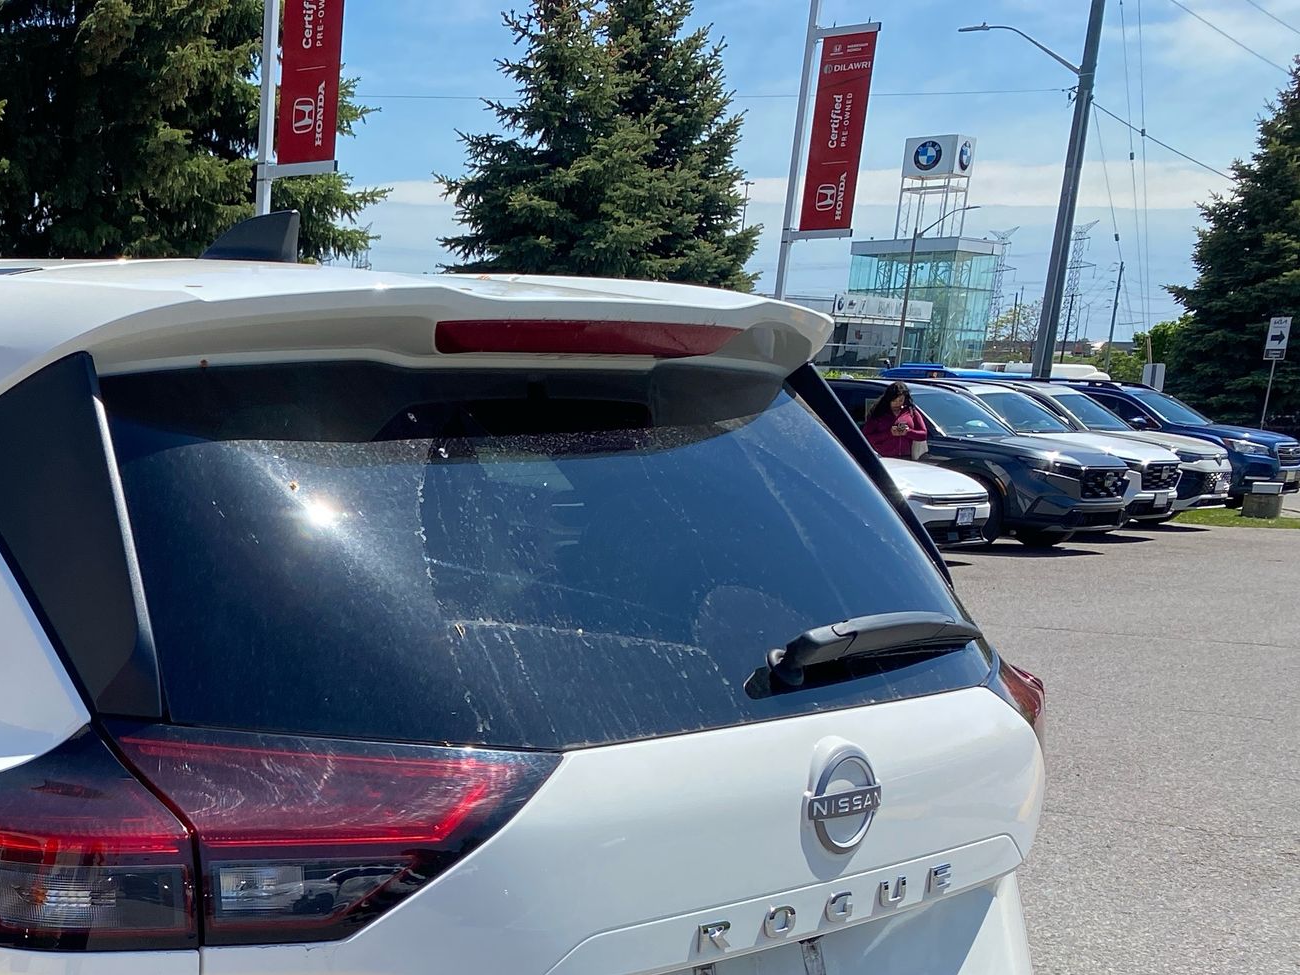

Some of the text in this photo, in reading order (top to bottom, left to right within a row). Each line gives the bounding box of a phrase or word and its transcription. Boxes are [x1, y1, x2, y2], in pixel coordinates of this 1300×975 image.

[302, 0, 316, 49] Certif
[833, 61, 871, 72] DILAWRI
[315, 80, 325, 147] HONDA
[828, 94, 843, 149] Certified
[840, 92, 853, 147] PRE-OWNED
[835, 172, 847, 221] HONDA
[813, 792, 881, 816] NISSAN
[698, 863, 951, 953] ROGUE
